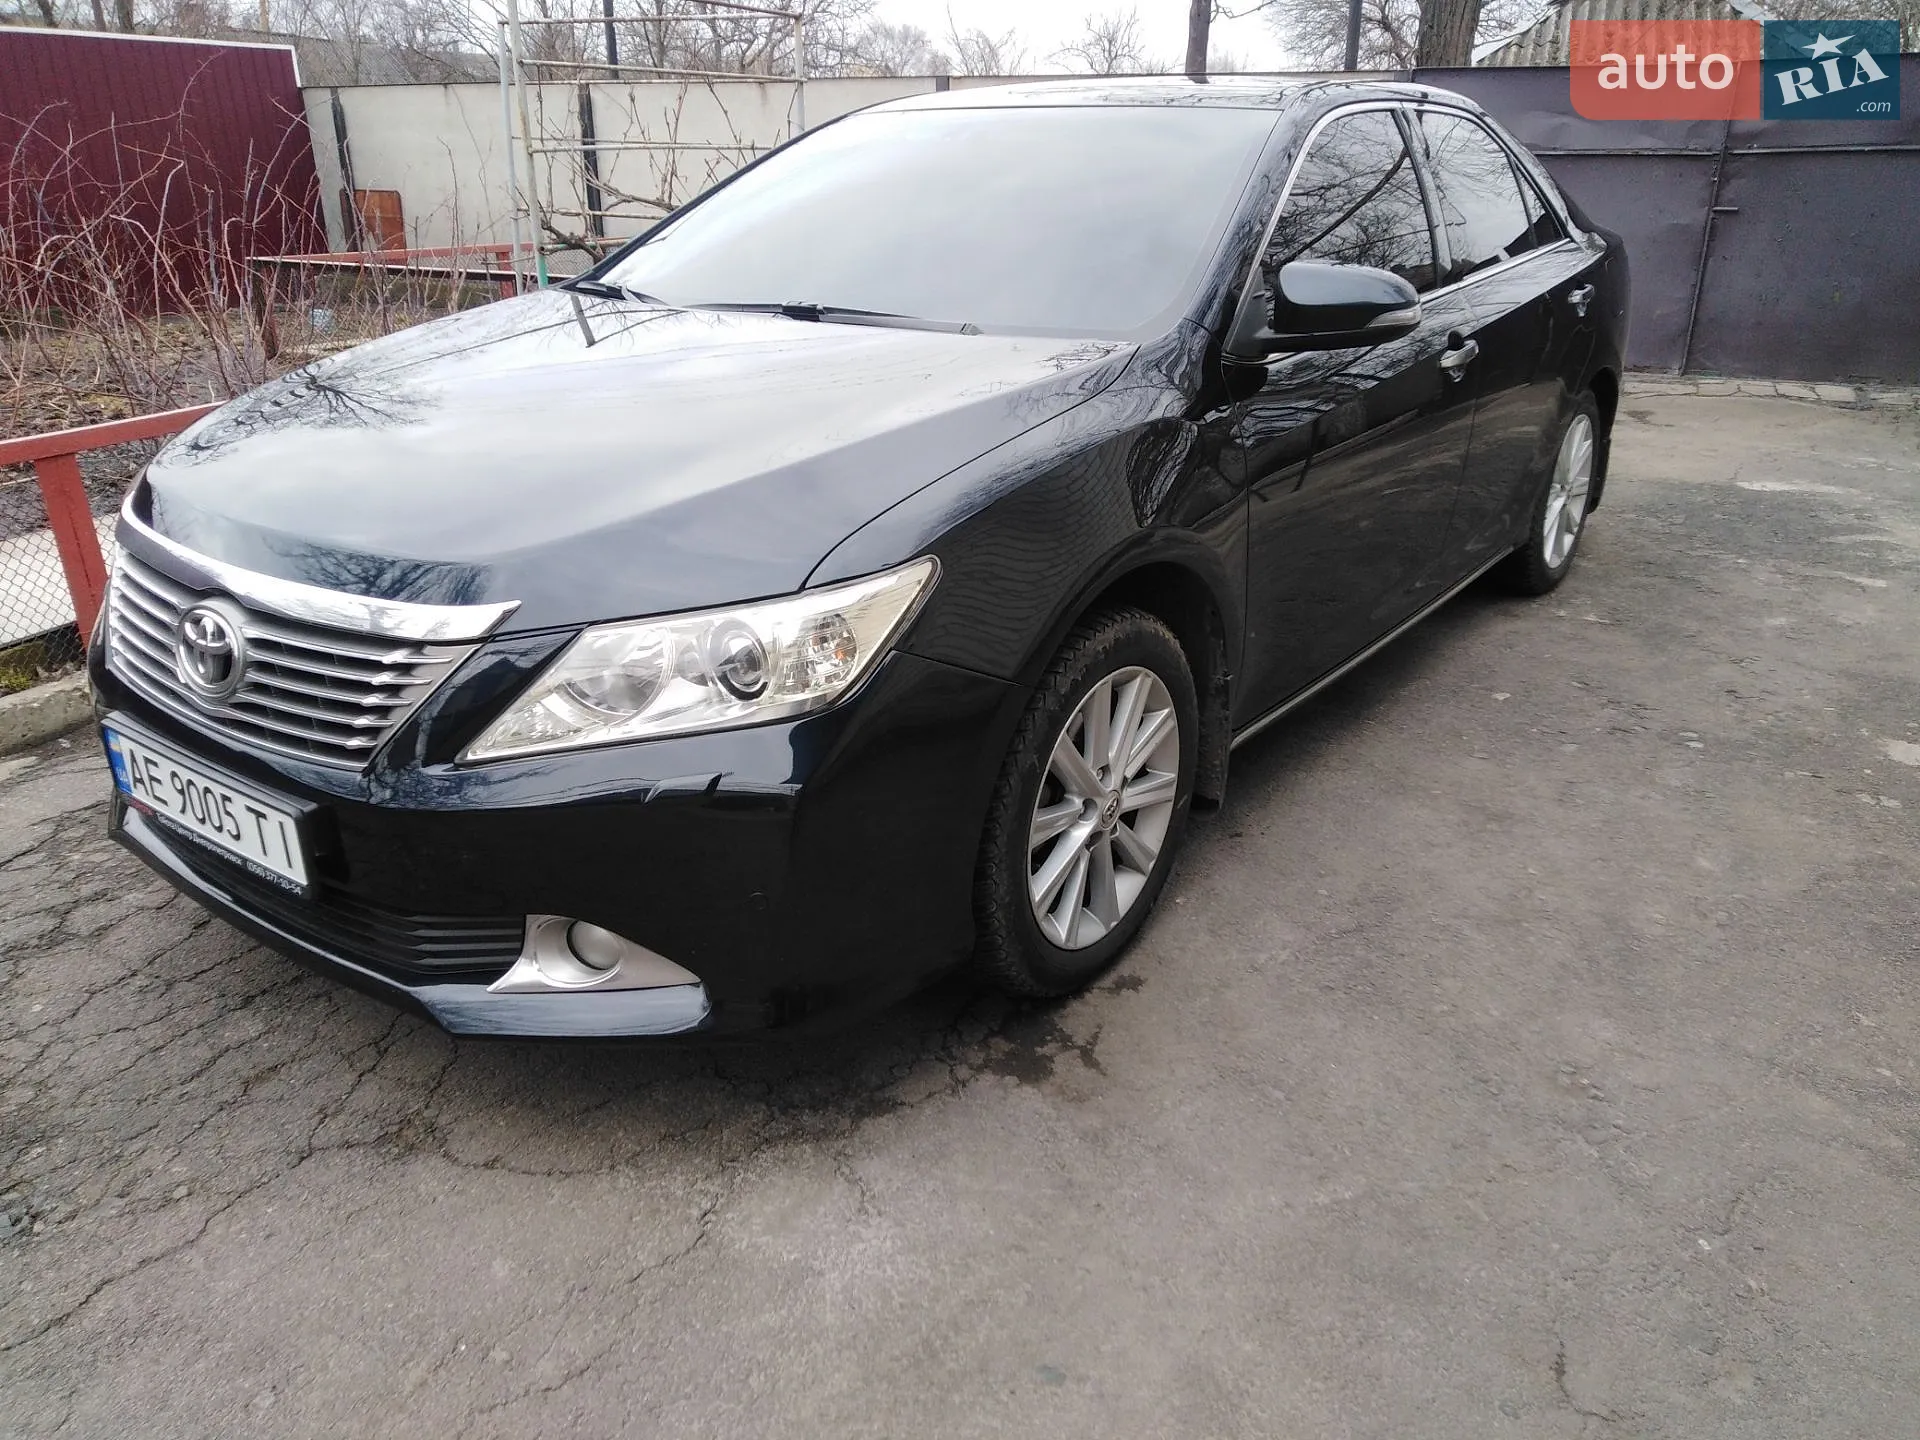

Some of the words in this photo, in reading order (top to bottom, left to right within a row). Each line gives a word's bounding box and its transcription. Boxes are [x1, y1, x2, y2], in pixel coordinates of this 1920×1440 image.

[129, 749, 168, 807] AE
[169, 770, 241, 842] 9005
[244, 803, 293, 869] TI
